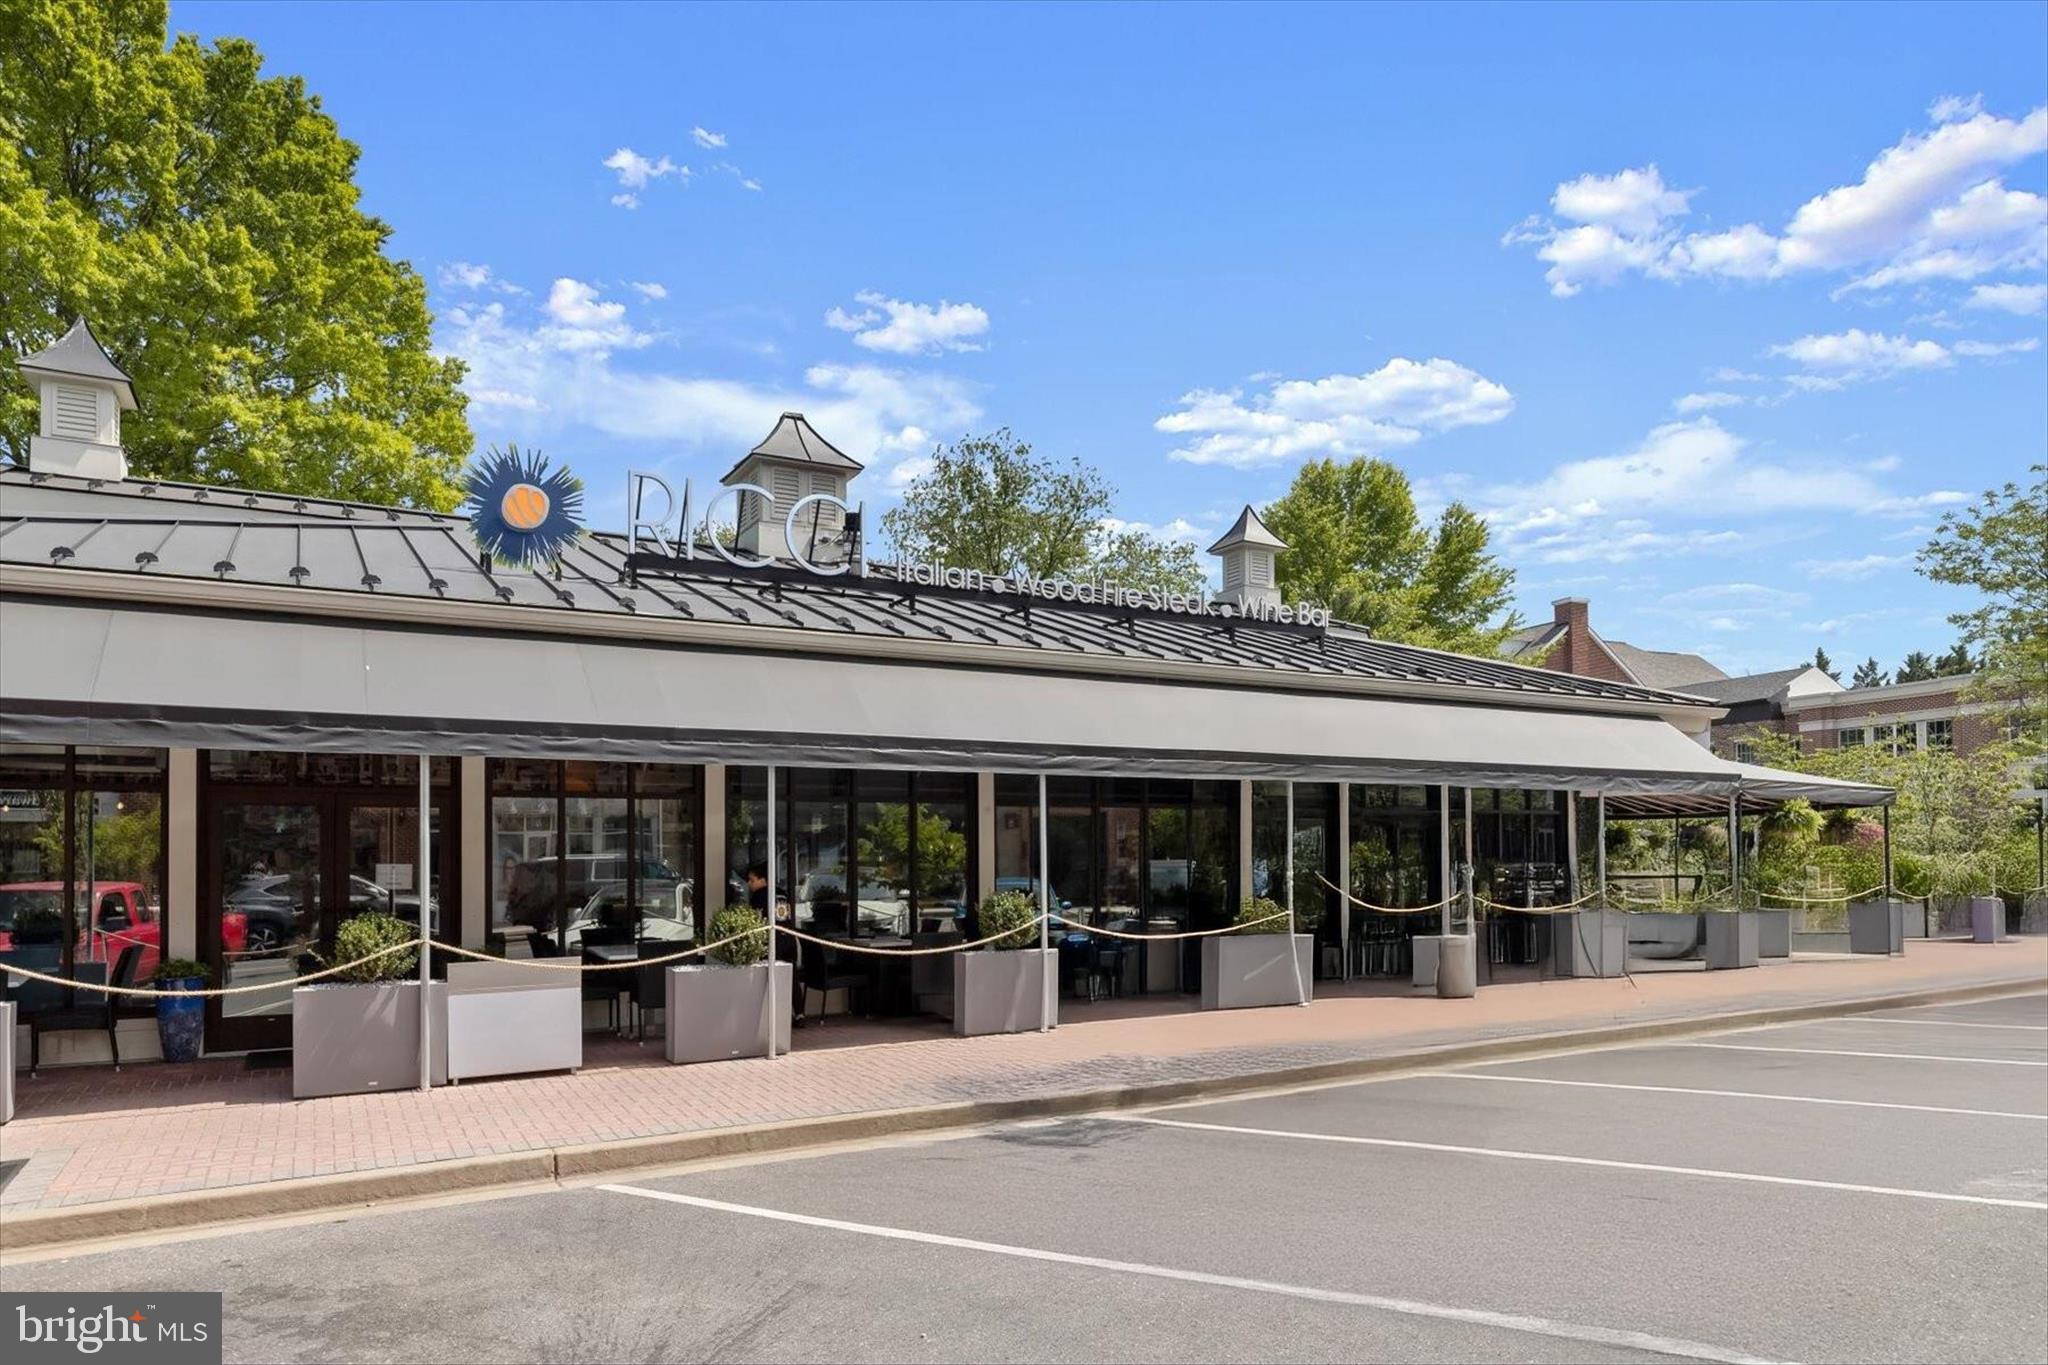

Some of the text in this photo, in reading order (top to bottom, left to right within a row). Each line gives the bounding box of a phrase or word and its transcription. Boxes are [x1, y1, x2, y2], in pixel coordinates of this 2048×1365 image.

[628, 469, 869, 578] RICCI
[896, 553, 1333, 627] Italian Wood Fire Steak Wine Bar
